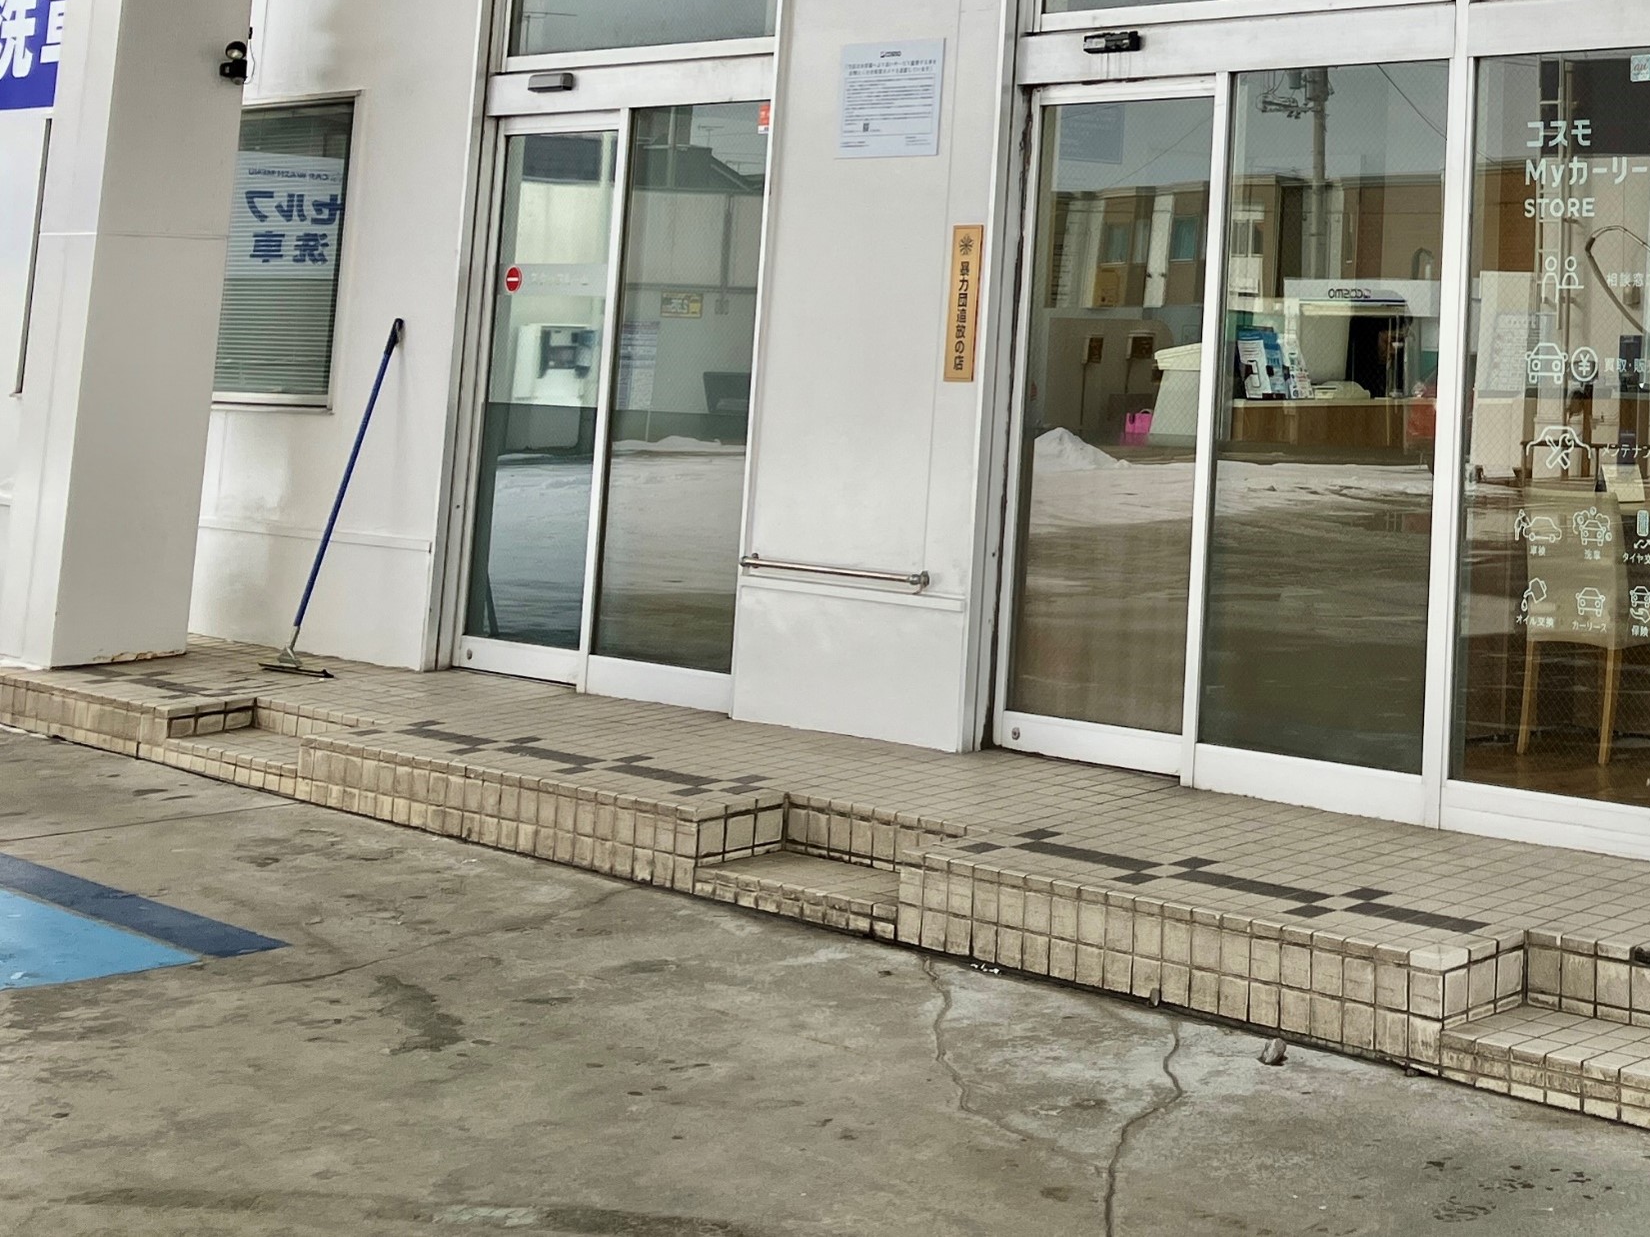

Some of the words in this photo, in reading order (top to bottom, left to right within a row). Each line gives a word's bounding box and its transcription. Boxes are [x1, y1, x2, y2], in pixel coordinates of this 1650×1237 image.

[1526, 119, 1591, 147] コスモ
[1524, 197, 1595, 218] STORE
